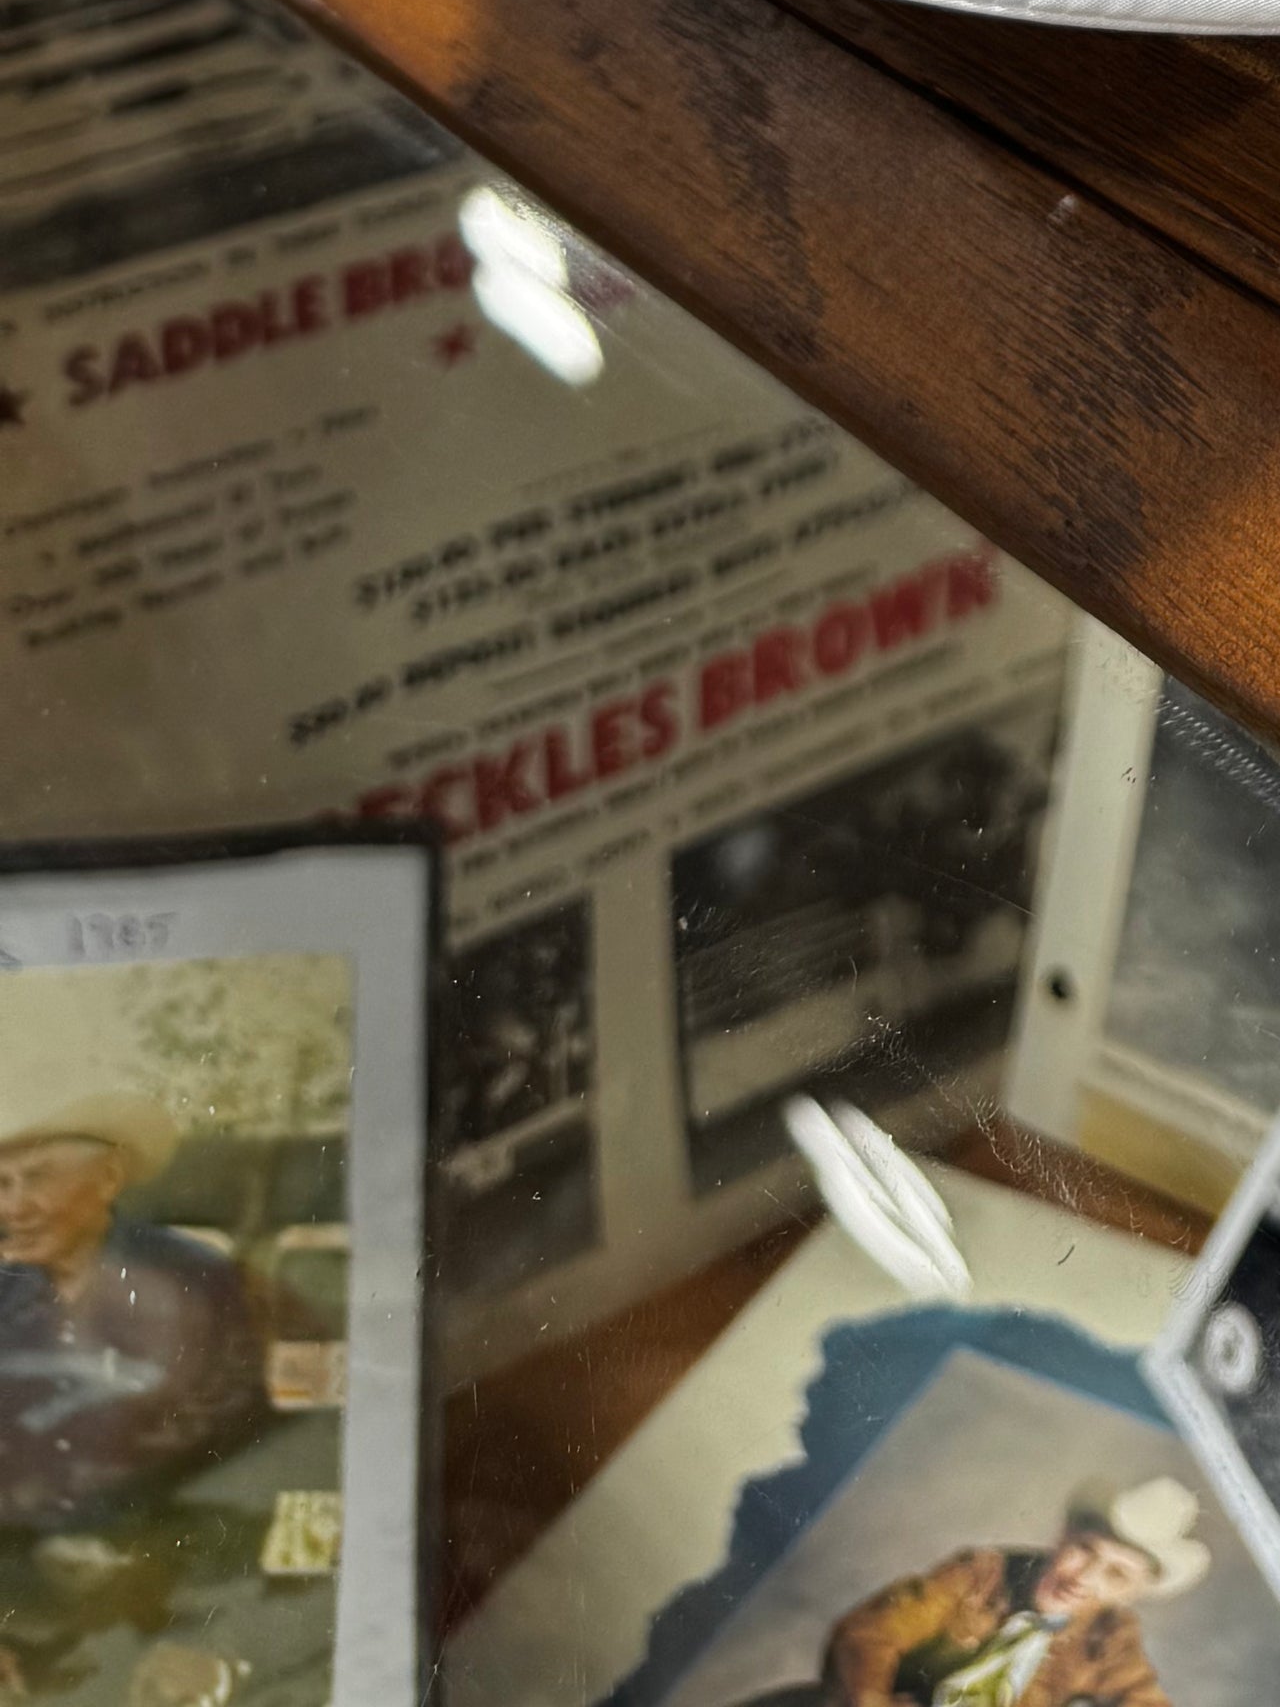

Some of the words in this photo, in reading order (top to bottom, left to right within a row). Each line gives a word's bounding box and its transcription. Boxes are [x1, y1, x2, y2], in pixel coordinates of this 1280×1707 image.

[61, 275, 333, 409] SADDLE
[318, 675, 680, 849] ECKLES
[694, 539, 1003, 732] BROWN
